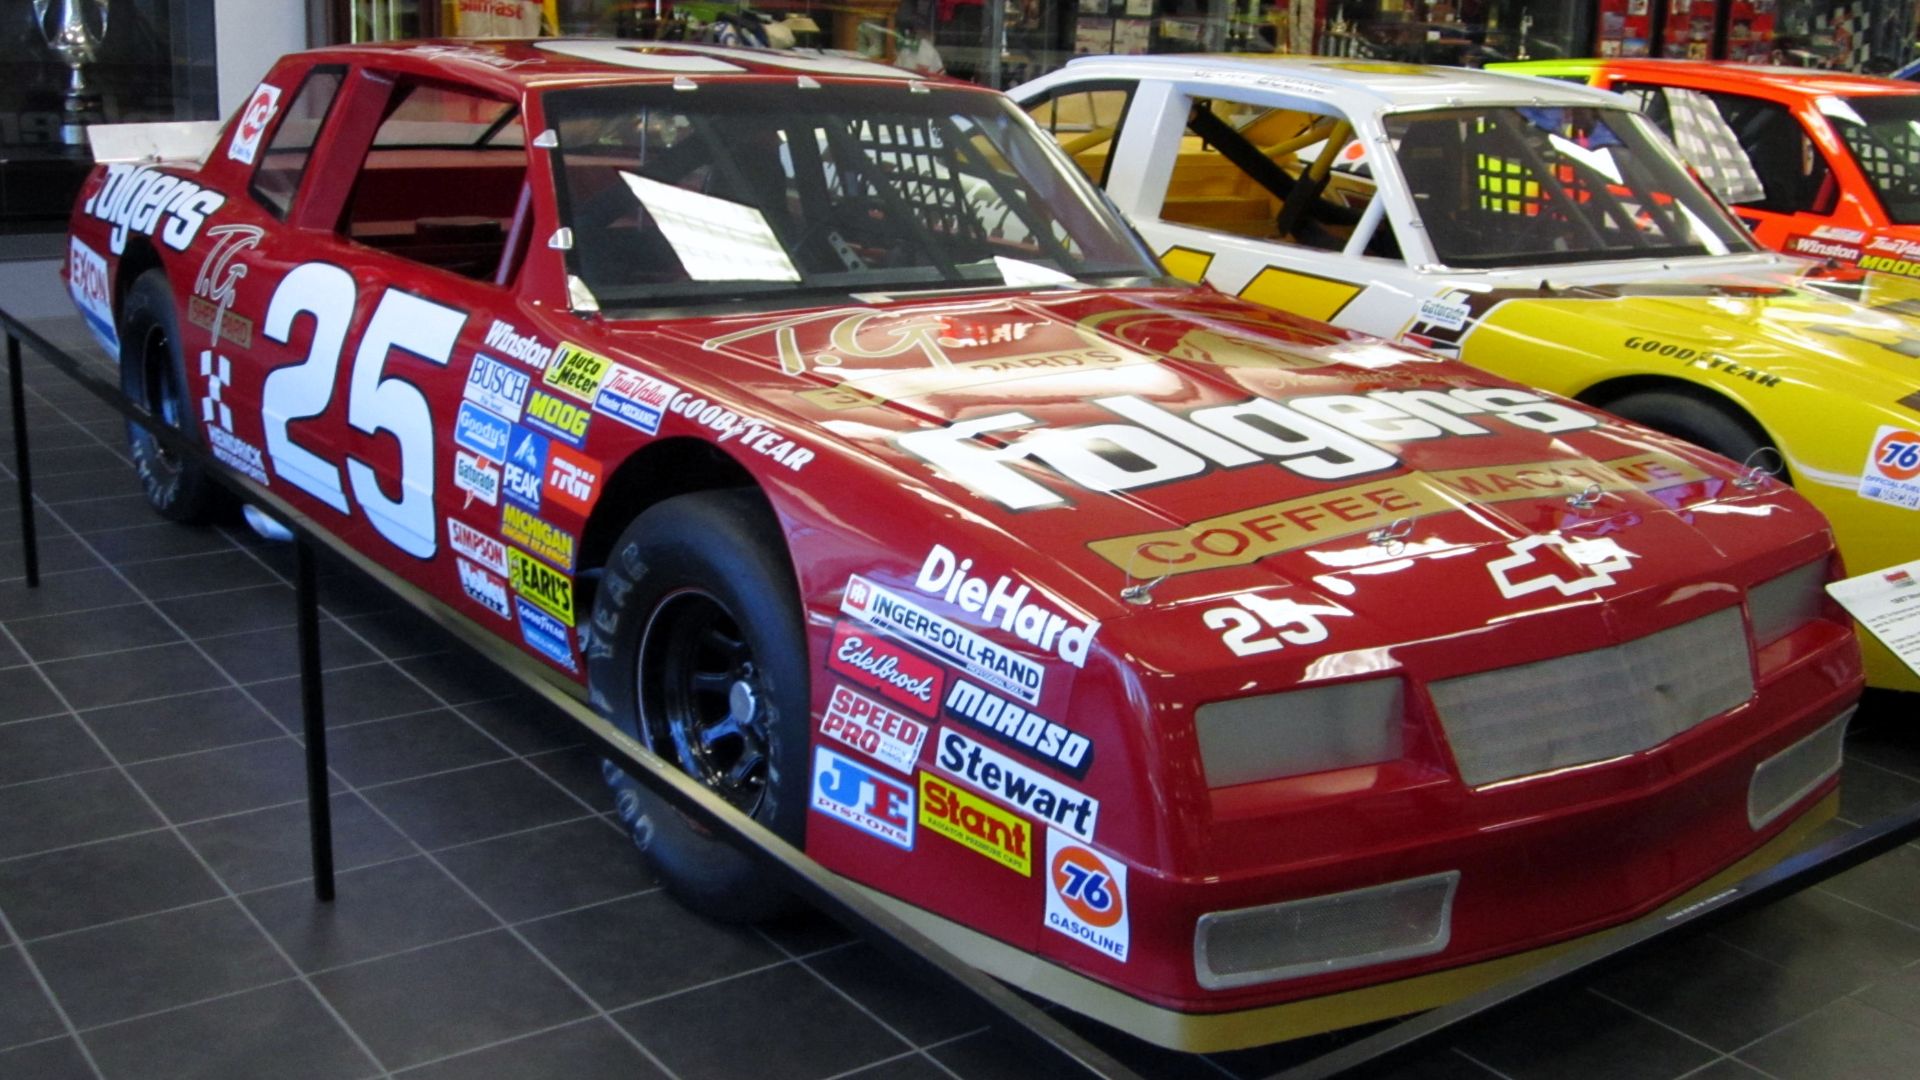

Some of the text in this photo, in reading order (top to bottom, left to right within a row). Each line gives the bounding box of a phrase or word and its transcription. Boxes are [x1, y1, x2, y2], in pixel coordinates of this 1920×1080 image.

[84, 164, 226, 256] olgers
[1797, 238, 1859, 260] Winston
[71, 249, 108, 312] EXXON
[1421, 300, 1465, 320] Gatorade
[484, 319, 552, 370] Winston
[567, 351, 602, 376] Auto
[470, 356, 528, 406] BUSCH
[560, 366, 599, 394] Meter
[261, 261, 470, 560] 25
[459, 410, 507, 447] Goody's
[527, 390, 591, 437] MOOG
[669, 392, 815, 471] GOODYEAR
[458, 458, 496, 494] Gatorade
[897, 388, 1600, 511] Folgers
[1882, 442, 1919, 468] 76
[502, 462, 542, 503] PEAK
[550, 456, 596, 501] TRW
[503, 502, 574, 557] MICHIGAN
[1135, 459, 1684, 567] COFFEE MACHINE
[452, 522, 505, 565] SIMPSON
[520, 557, 571, 612] EARL'S
[915, 543, 1102, 669] DieHard
[872, 593, 1040, 691] INGERSOLL-RAND
[1203, 594, 1329, 657] 25
[837, 636, 933, 703] Edelbrock
[823, 711, 881, 754] PRO
[831, 688, 920, 747] SPEED
[946, 679, 1091, 768] MOROSO
[818, 756, 908, 832] JE
[940, 733, 1093, 836] Stewart
[817, 796, 909, 844] PISTONS
[923, 779, 1028, 860] Stant
[1063, 862, 1111, 911] 76
[1049, 911, 1125, 957] GASOLINE
